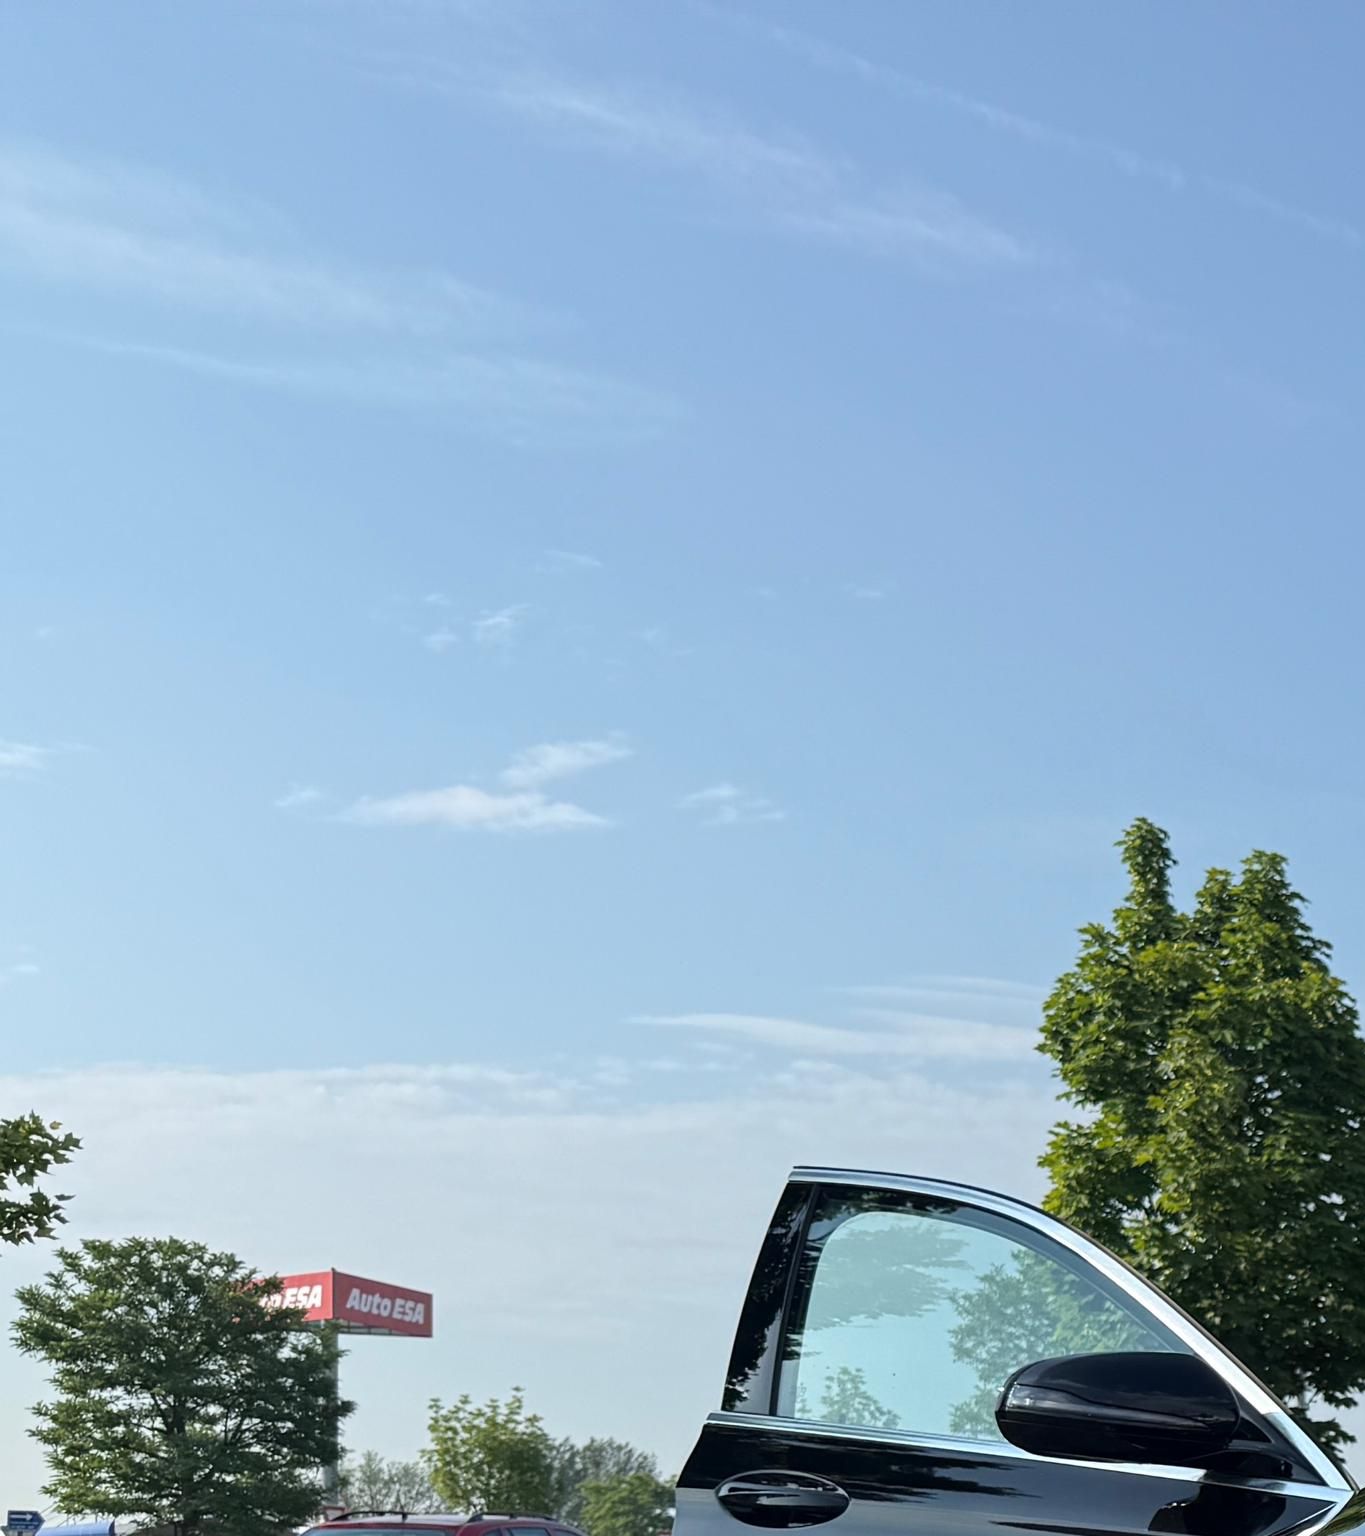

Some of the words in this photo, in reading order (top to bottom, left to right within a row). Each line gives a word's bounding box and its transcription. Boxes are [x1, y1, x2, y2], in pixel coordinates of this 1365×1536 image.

[282, 1284, 322, 1309] ESA
[346, 1287, 390, 1318] Auto
[391, 1298, 425, 1325] ESA
